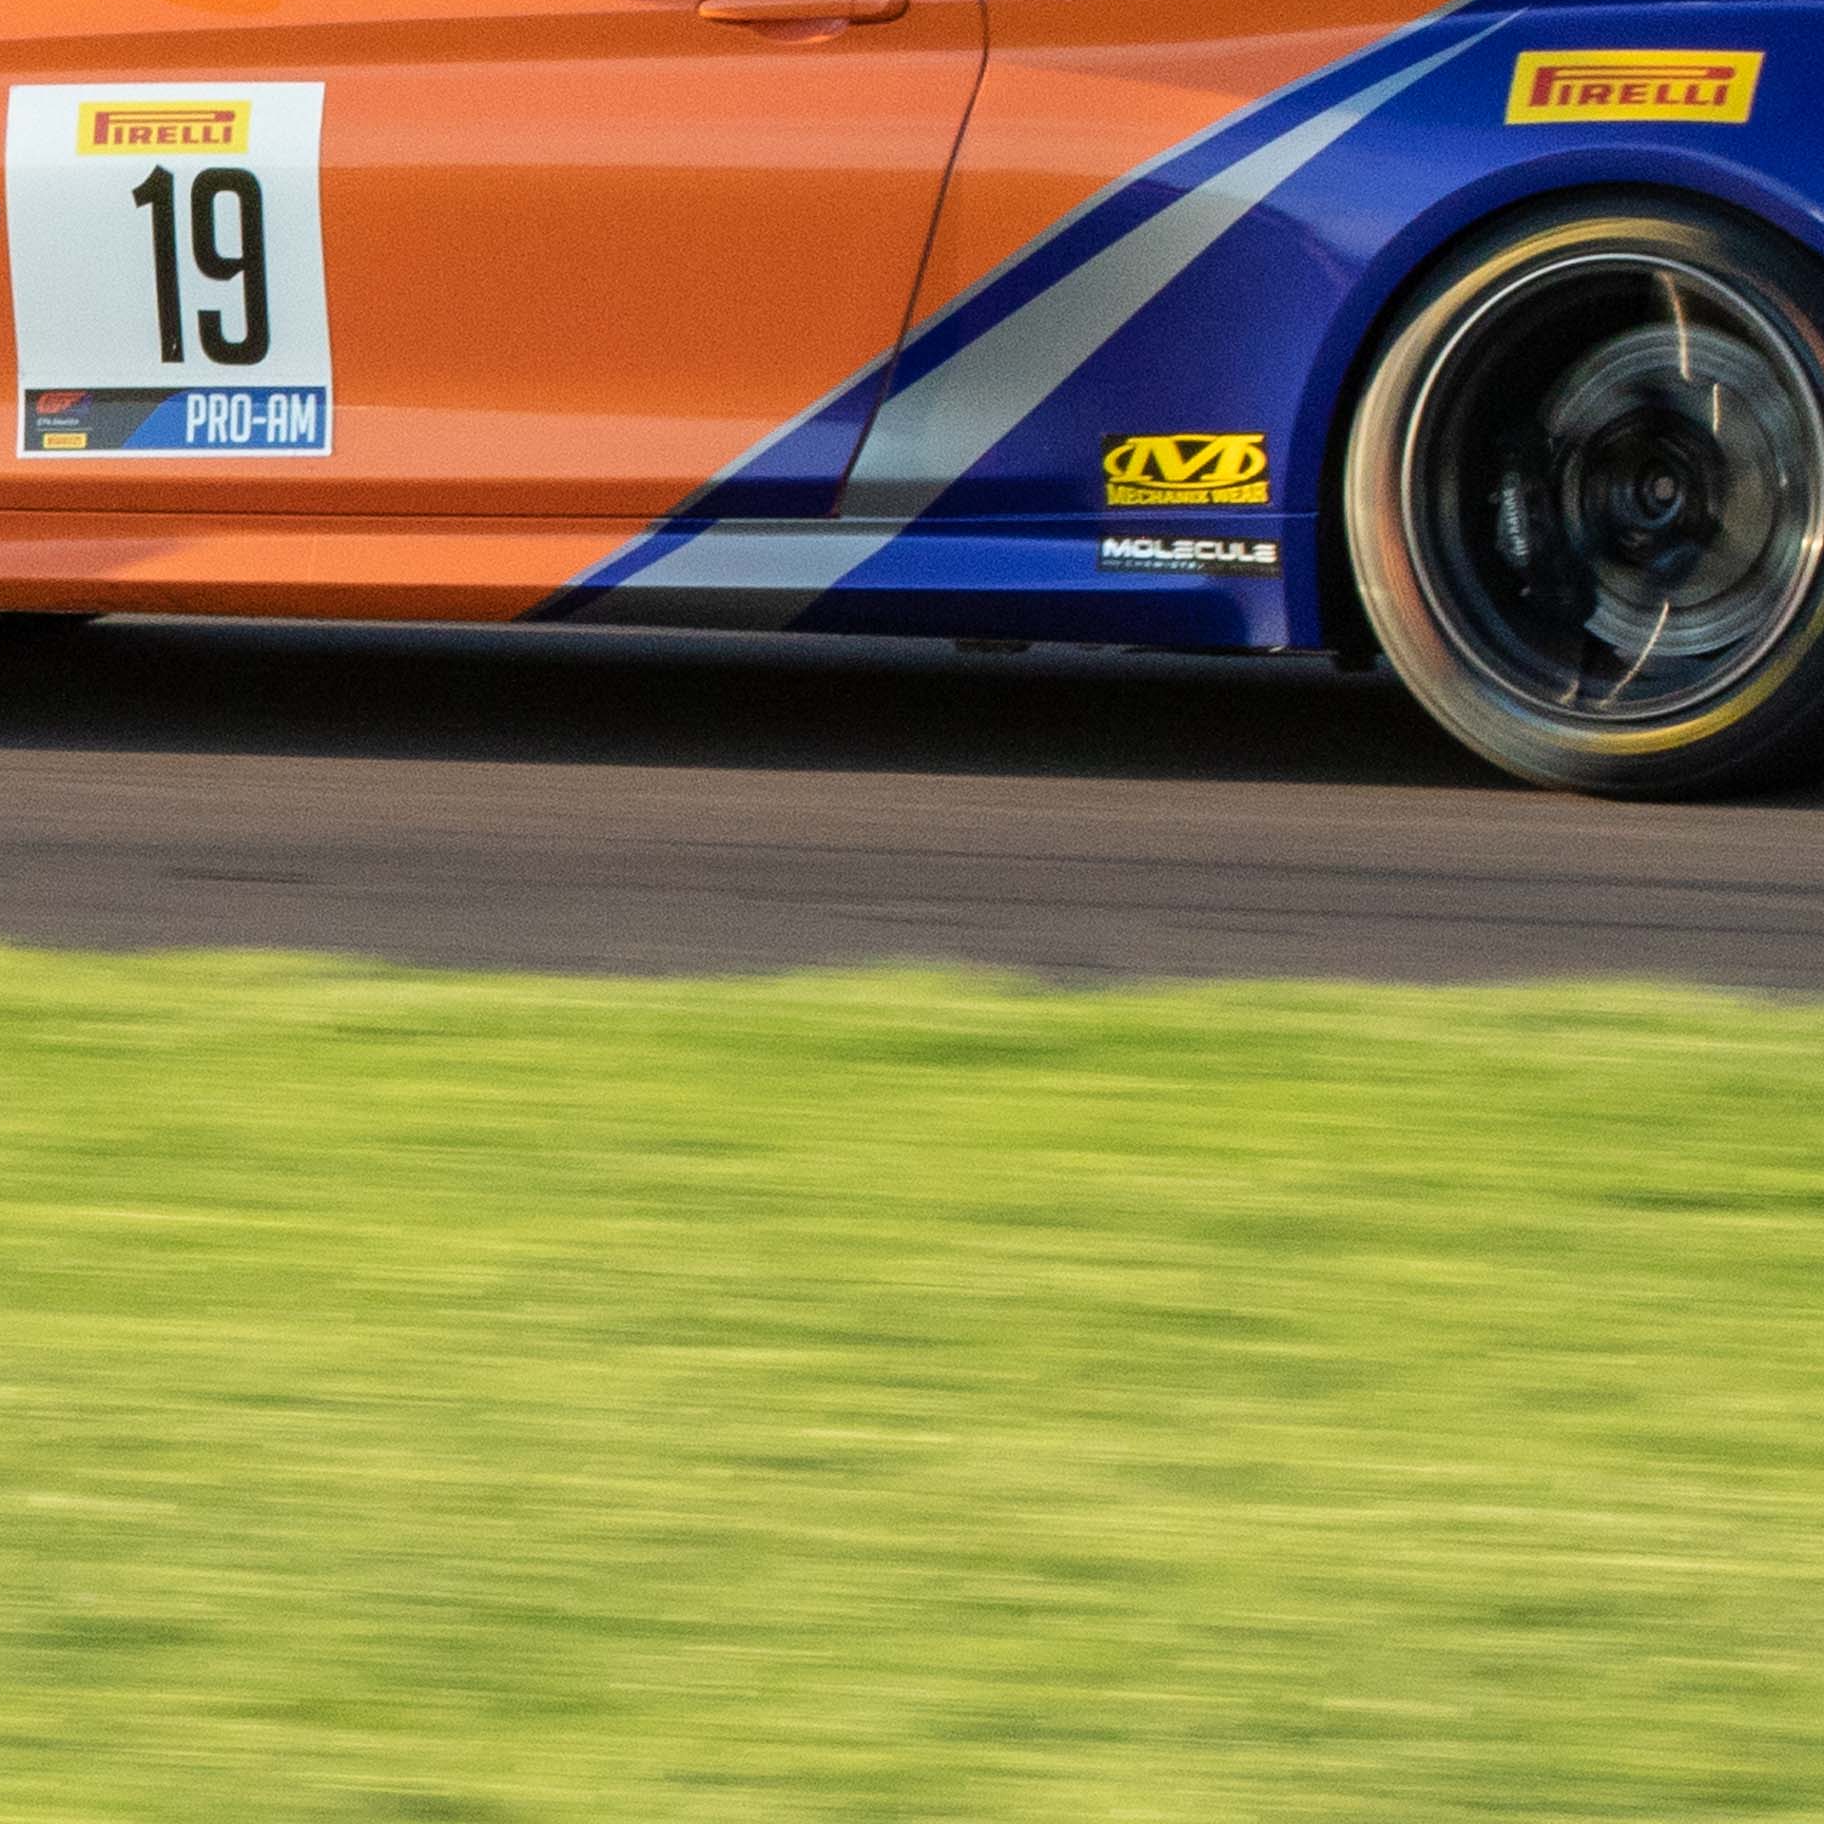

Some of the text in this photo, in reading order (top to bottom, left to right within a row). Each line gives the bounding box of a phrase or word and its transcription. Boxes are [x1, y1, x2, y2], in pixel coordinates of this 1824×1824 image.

[1529, 65, 1735, 107] PIRELLI
[93, 110, 236, 145] PIRELLI
[131, 164, 270, 365] 19
[186, 393, 316, 444] PRO-AM
[1103, 538, 1277, 563] MOLECULE
